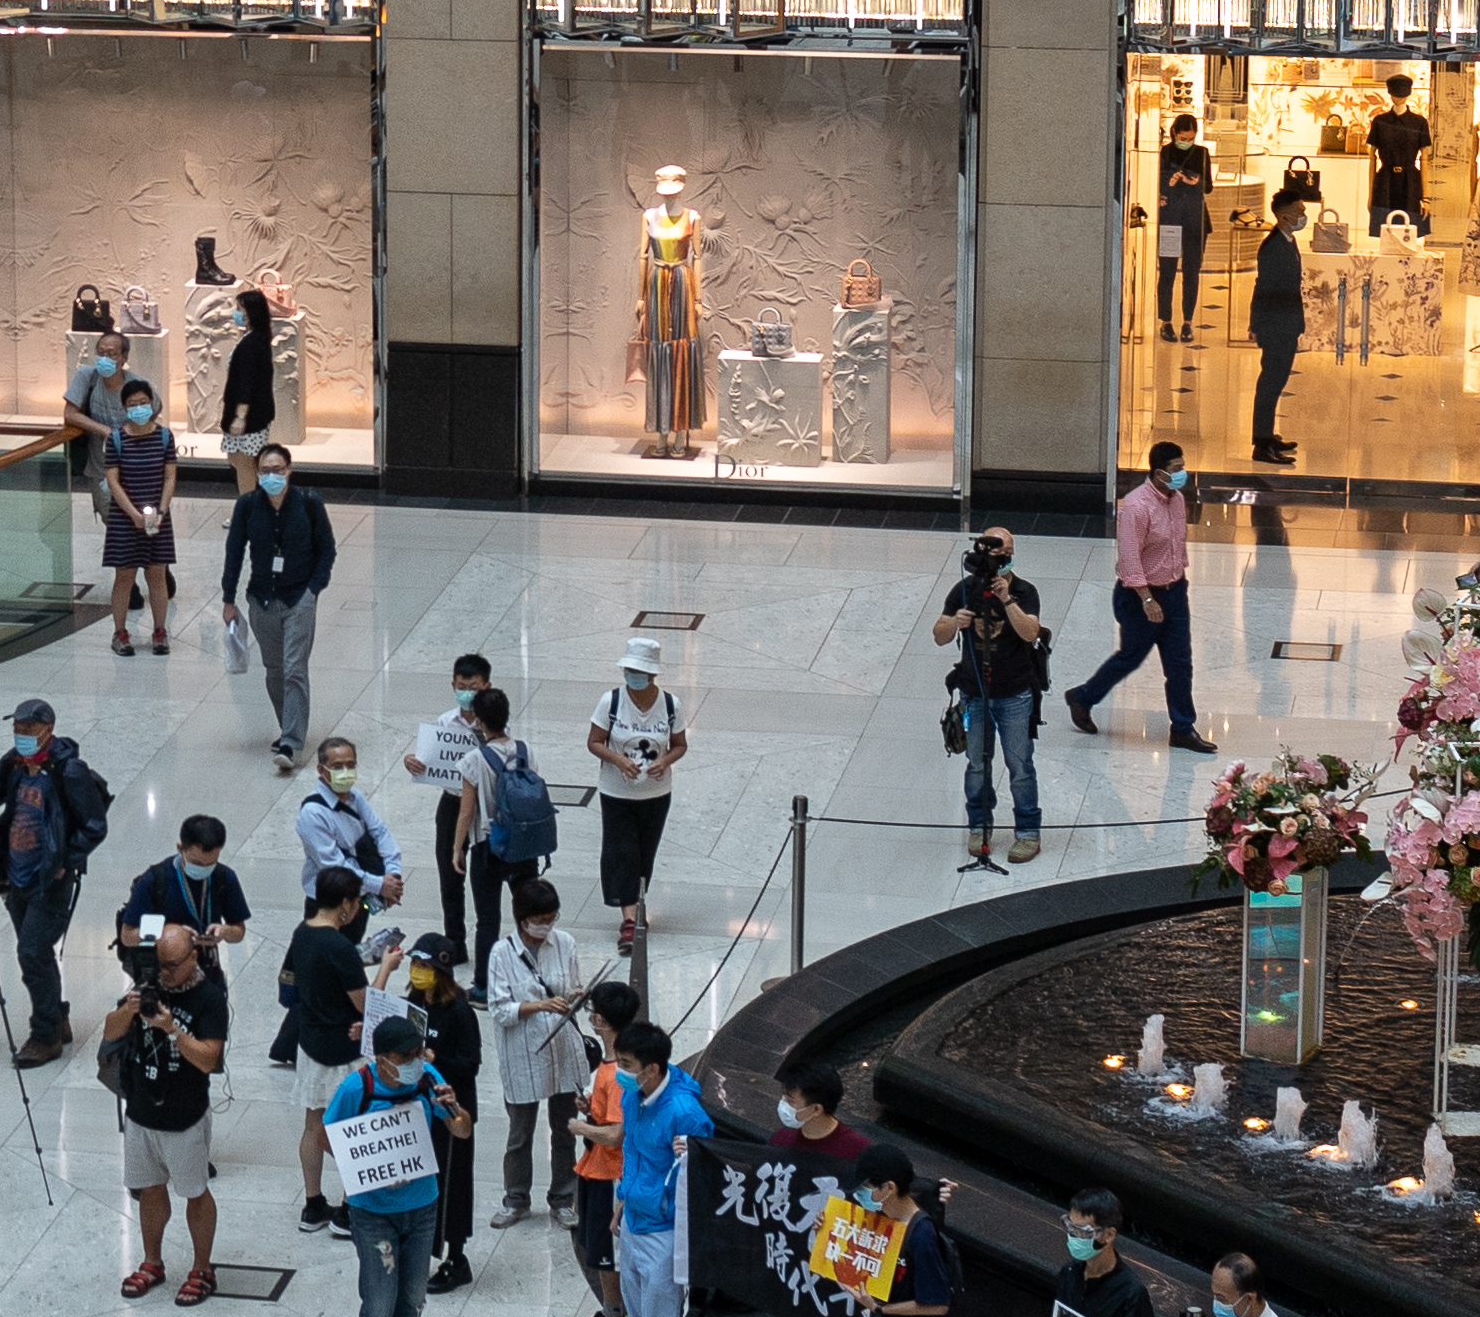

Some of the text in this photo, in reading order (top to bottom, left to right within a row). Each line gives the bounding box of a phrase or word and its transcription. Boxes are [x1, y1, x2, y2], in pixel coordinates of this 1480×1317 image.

[714, 453, 769, 478] Dior
[439, 750, 465, 761] LIVE
[427, 767, 462, 781] MATT
[342, 1110, 411, 1139] WE CAN'T
[349, 1130, 418, 1160] BREATHE!
[357, 1155, 425, 1185] FREE HK
[830, 1216, 889, 1254] 五大訴求
[824, 1242, 883, 1278] 缺一不可
